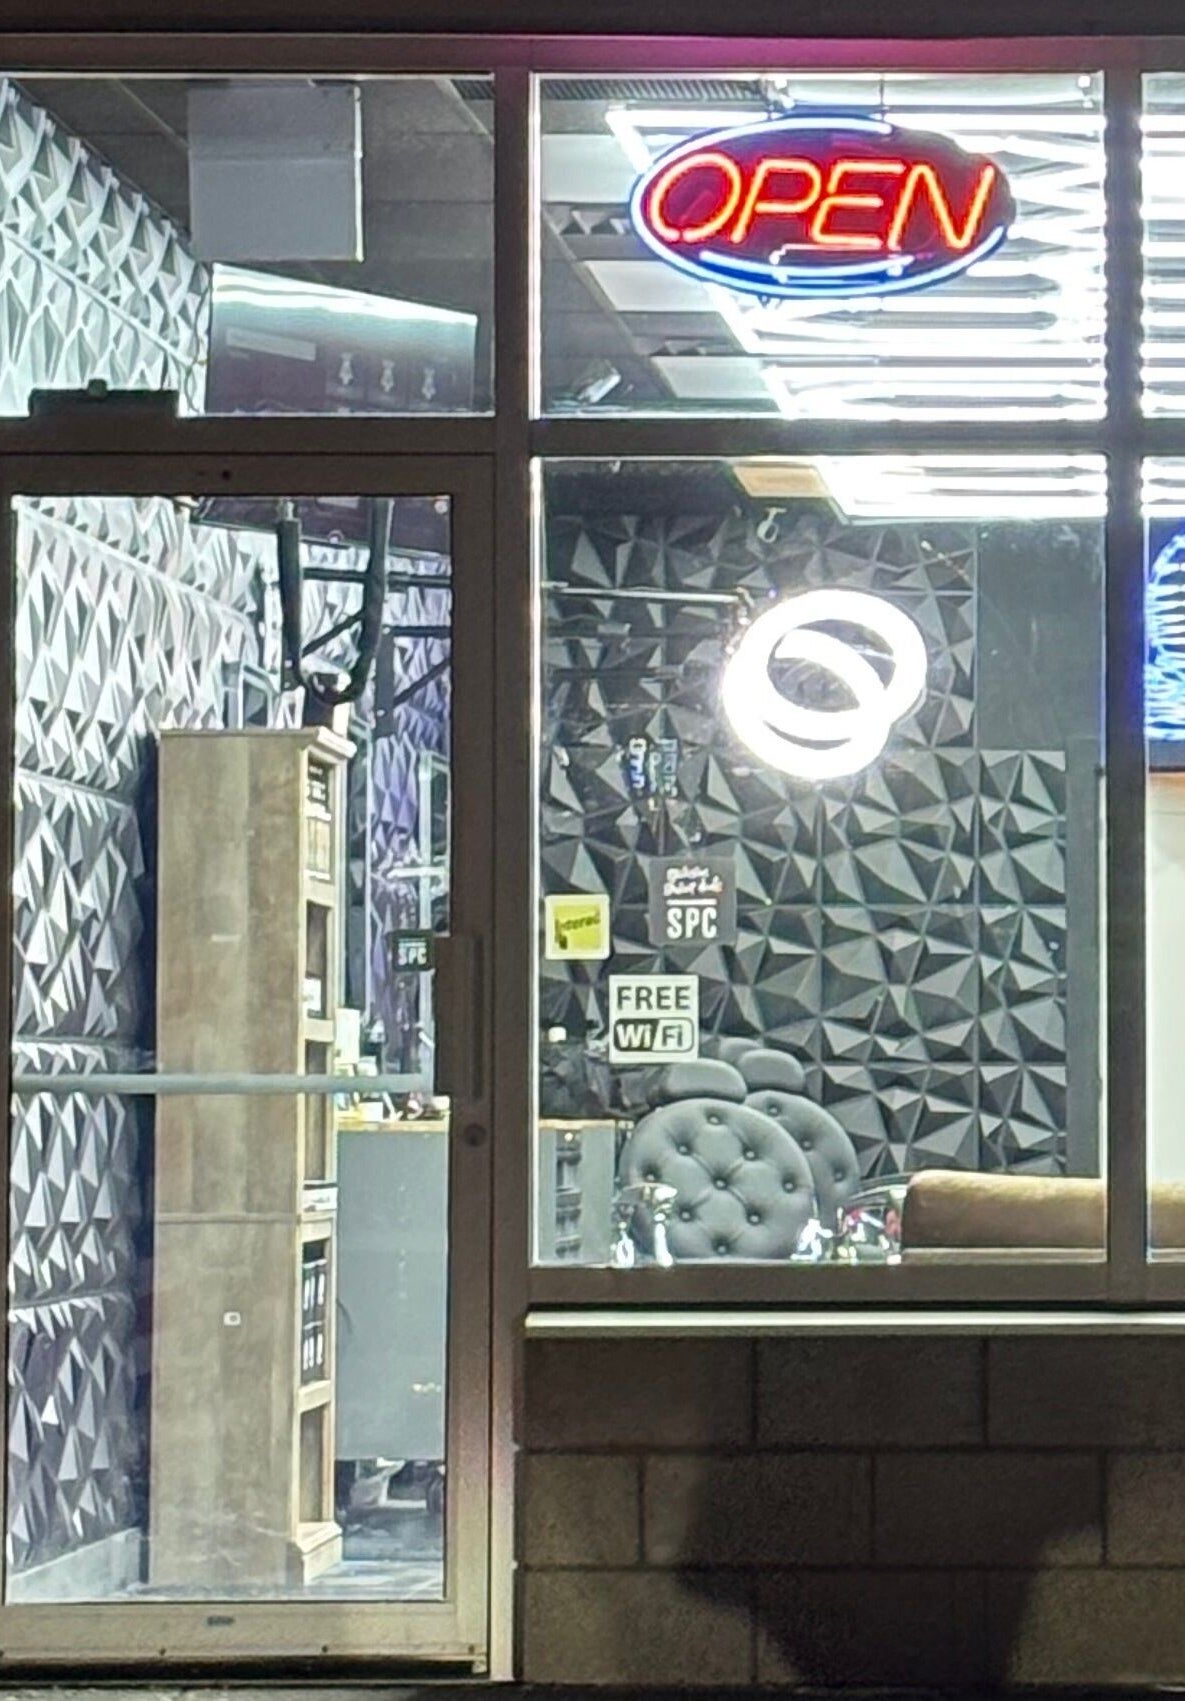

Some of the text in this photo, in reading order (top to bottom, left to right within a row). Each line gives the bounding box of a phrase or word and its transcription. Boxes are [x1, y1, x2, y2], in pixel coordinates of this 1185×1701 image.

[648, 152, 996, 251] OPEN
[666, 907, 718, 939] SPC
[398, 947, 427, 966] SPC
[616, 985, 691, 1010] FREE
